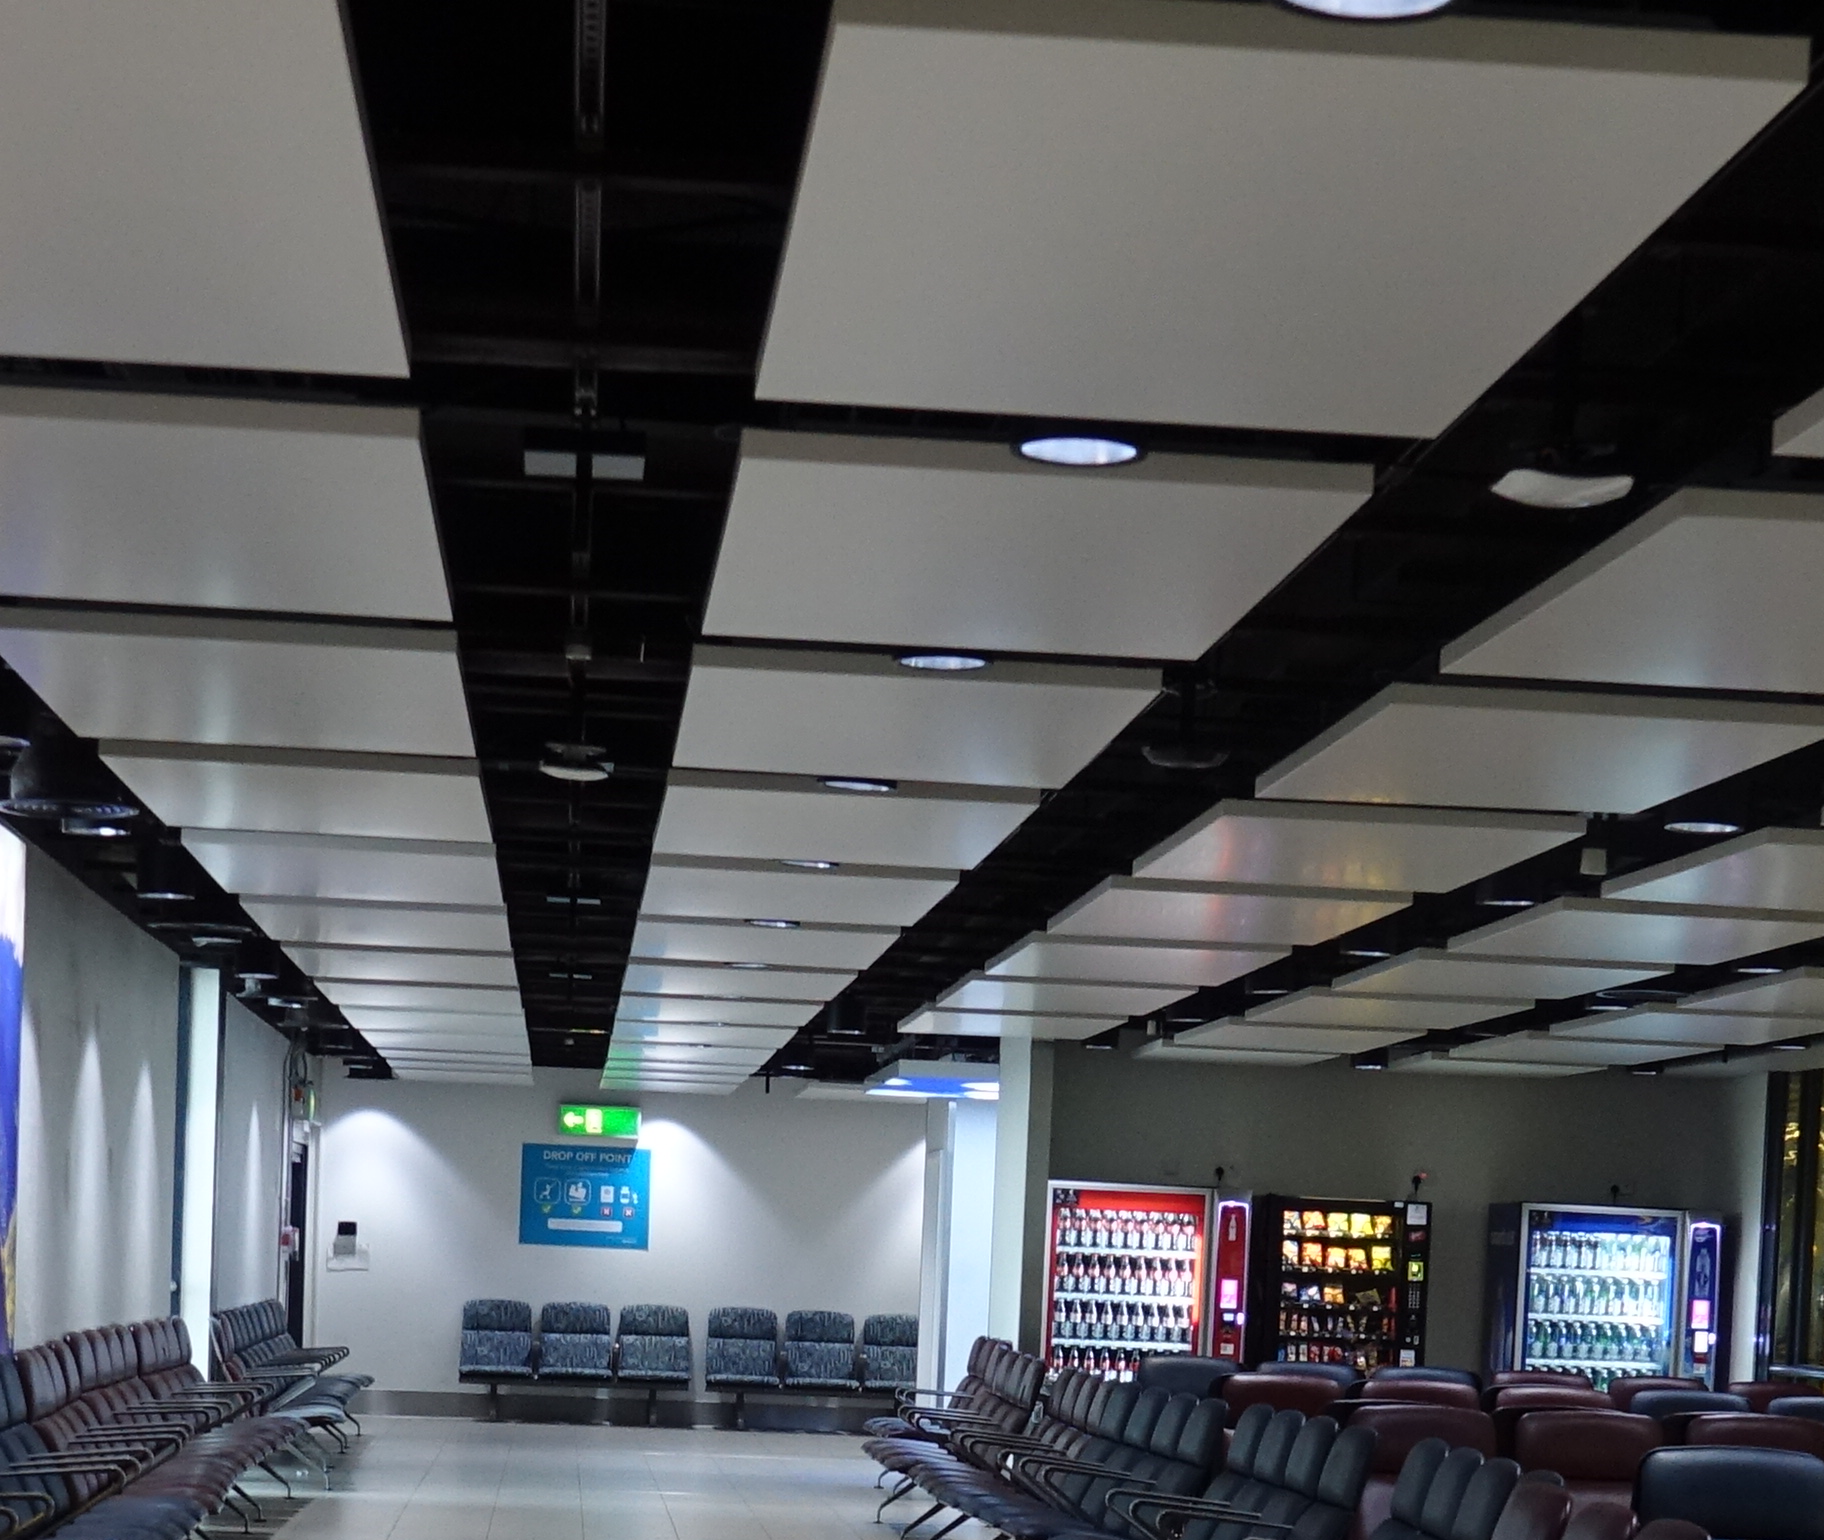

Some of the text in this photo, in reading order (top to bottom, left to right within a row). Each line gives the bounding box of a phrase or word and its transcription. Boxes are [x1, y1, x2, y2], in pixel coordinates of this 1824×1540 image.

[543, 1150, 632, 1164] DROP OFF POINT
